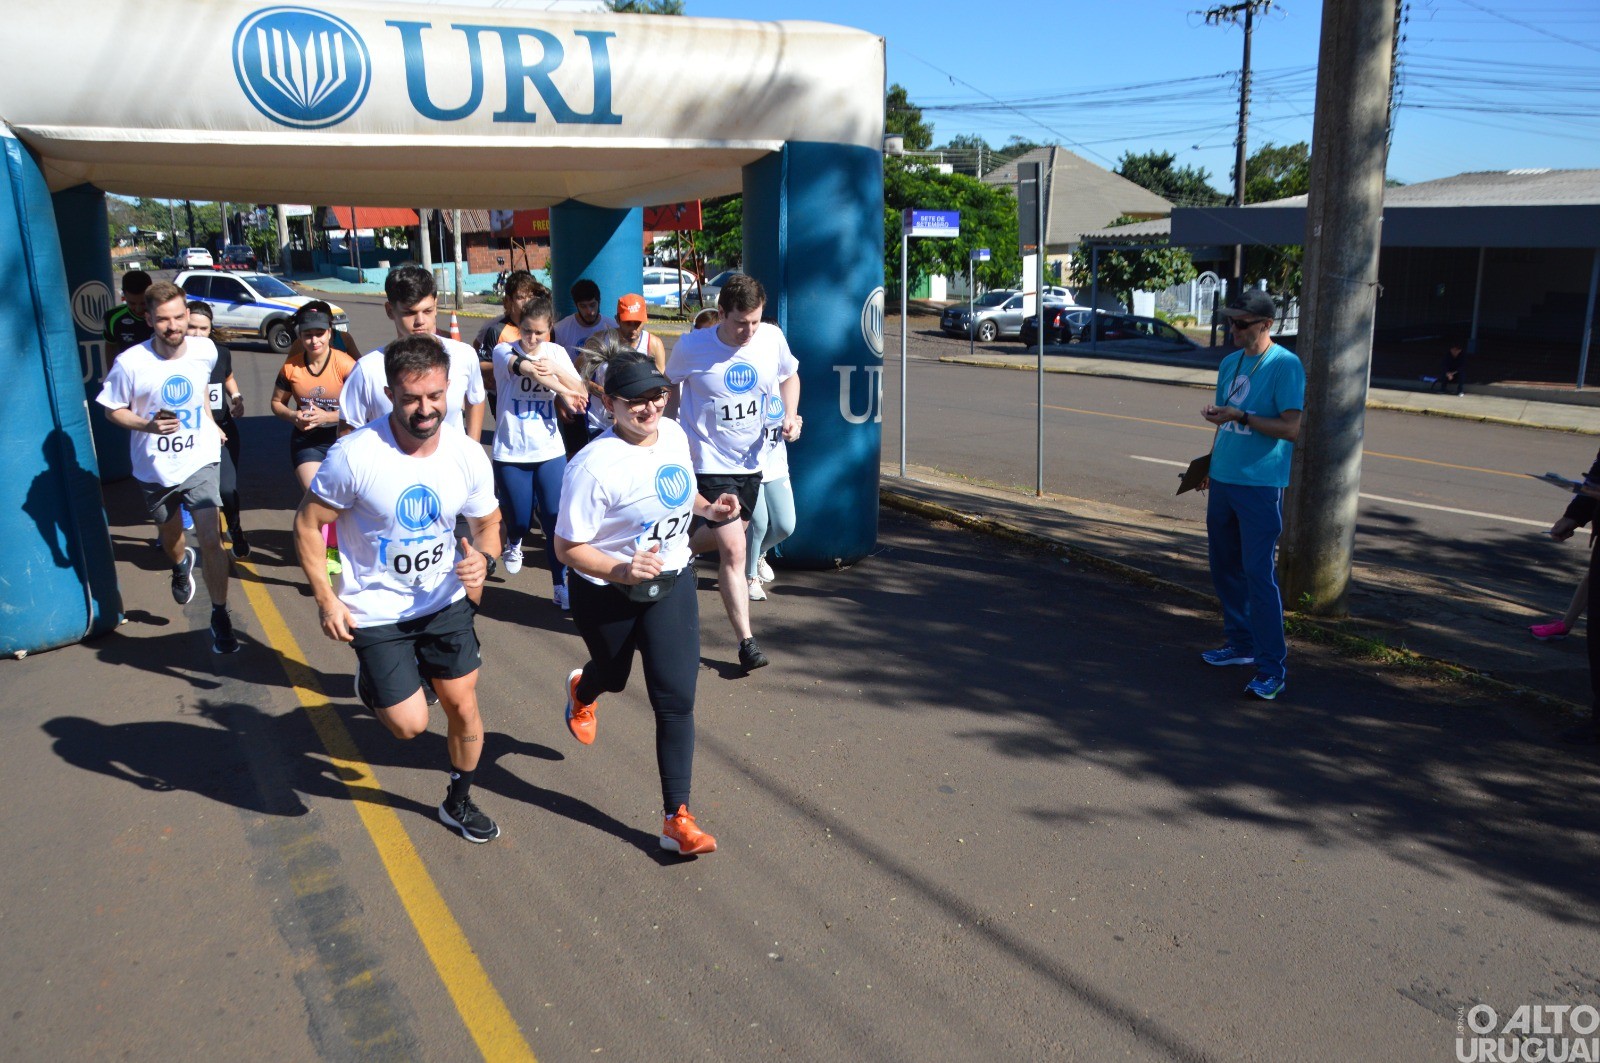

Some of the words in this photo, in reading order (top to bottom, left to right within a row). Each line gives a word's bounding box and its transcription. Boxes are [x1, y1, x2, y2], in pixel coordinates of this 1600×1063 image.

[385, 20, 623, 125] URI
[512, 398, 553, 420] URI
[721, 400, 758, 421] 114
[157, 434, 195, 453] 064
[647, 510, 691, 541] 127
[393, 542, 444, 575] 068
